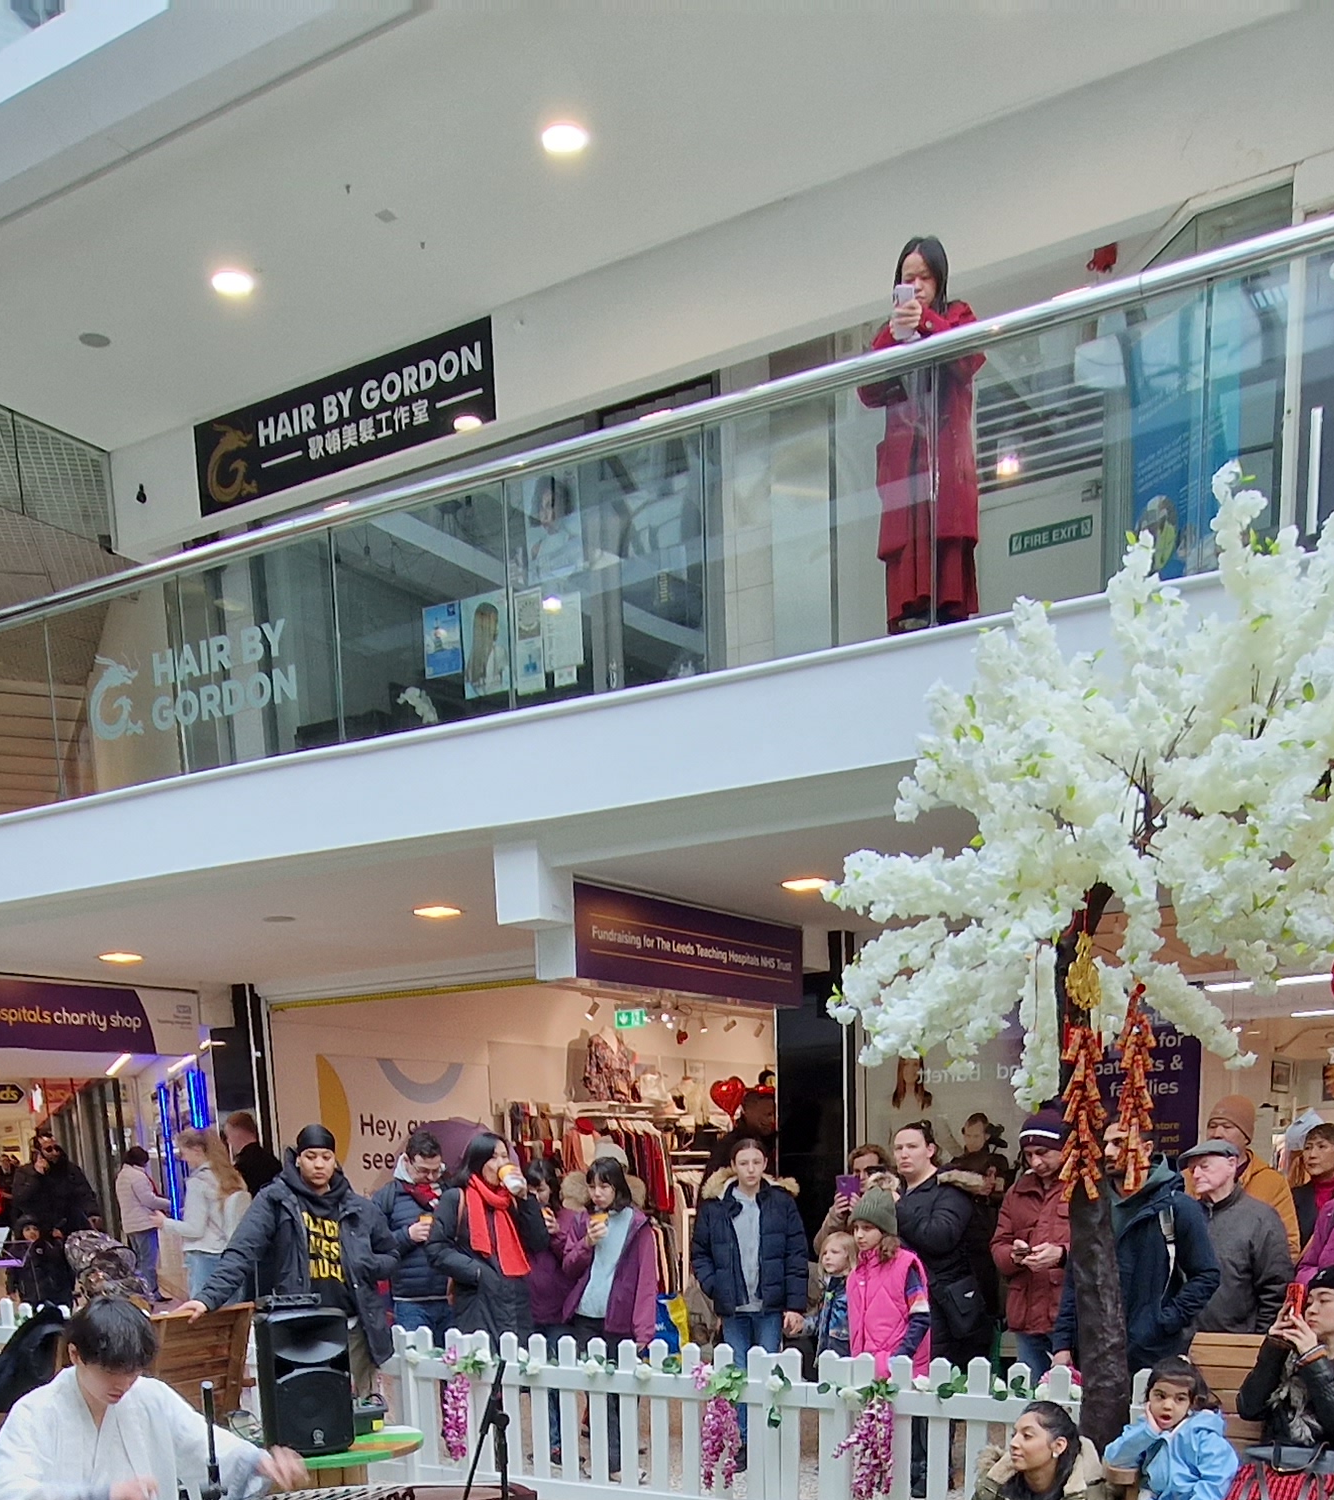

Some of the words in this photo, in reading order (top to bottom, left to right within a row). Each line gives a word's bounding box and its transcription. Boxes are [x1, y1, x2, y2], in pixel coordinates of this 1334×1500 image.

[257, 403, 317, 447] HAIR
[322, 387, 354, 425] BY
[360, 341, 483, 410] GORDON
[1023, 532, 1049, 549] FIRE
[1052, 525, 1077, 542] EXIT
[152, 634, 232, 686] HAIR
[241, 618, 285, 664] BY
[151, 664, 297, 731] GORDON
[592, 925, 642, 949] Fundraising
[643, 934, 655, 948] for
[656, 936, 671, 952] The
[672, 940, 695, 956] Leeds
[696, 943, 727, 963] Teaching
[728, 950, 760, 967] Hospitals
[761, 956, 776, 969] NHS
[776, 958, 792, 972] Trust
[53, 1007, 107, 1032] charity
[109, 1010, 142, 1033] shop
[1158, 1032, 1184, 1048] for
[1094, 1057, 1165, 1076] patts
[1170, 1054, 1184, 1071] &
[1109, 1078, 1179, 1098] falies
[360, 1113, 402, 1142] Hey,
[362, 1153, 395, 1170] see
